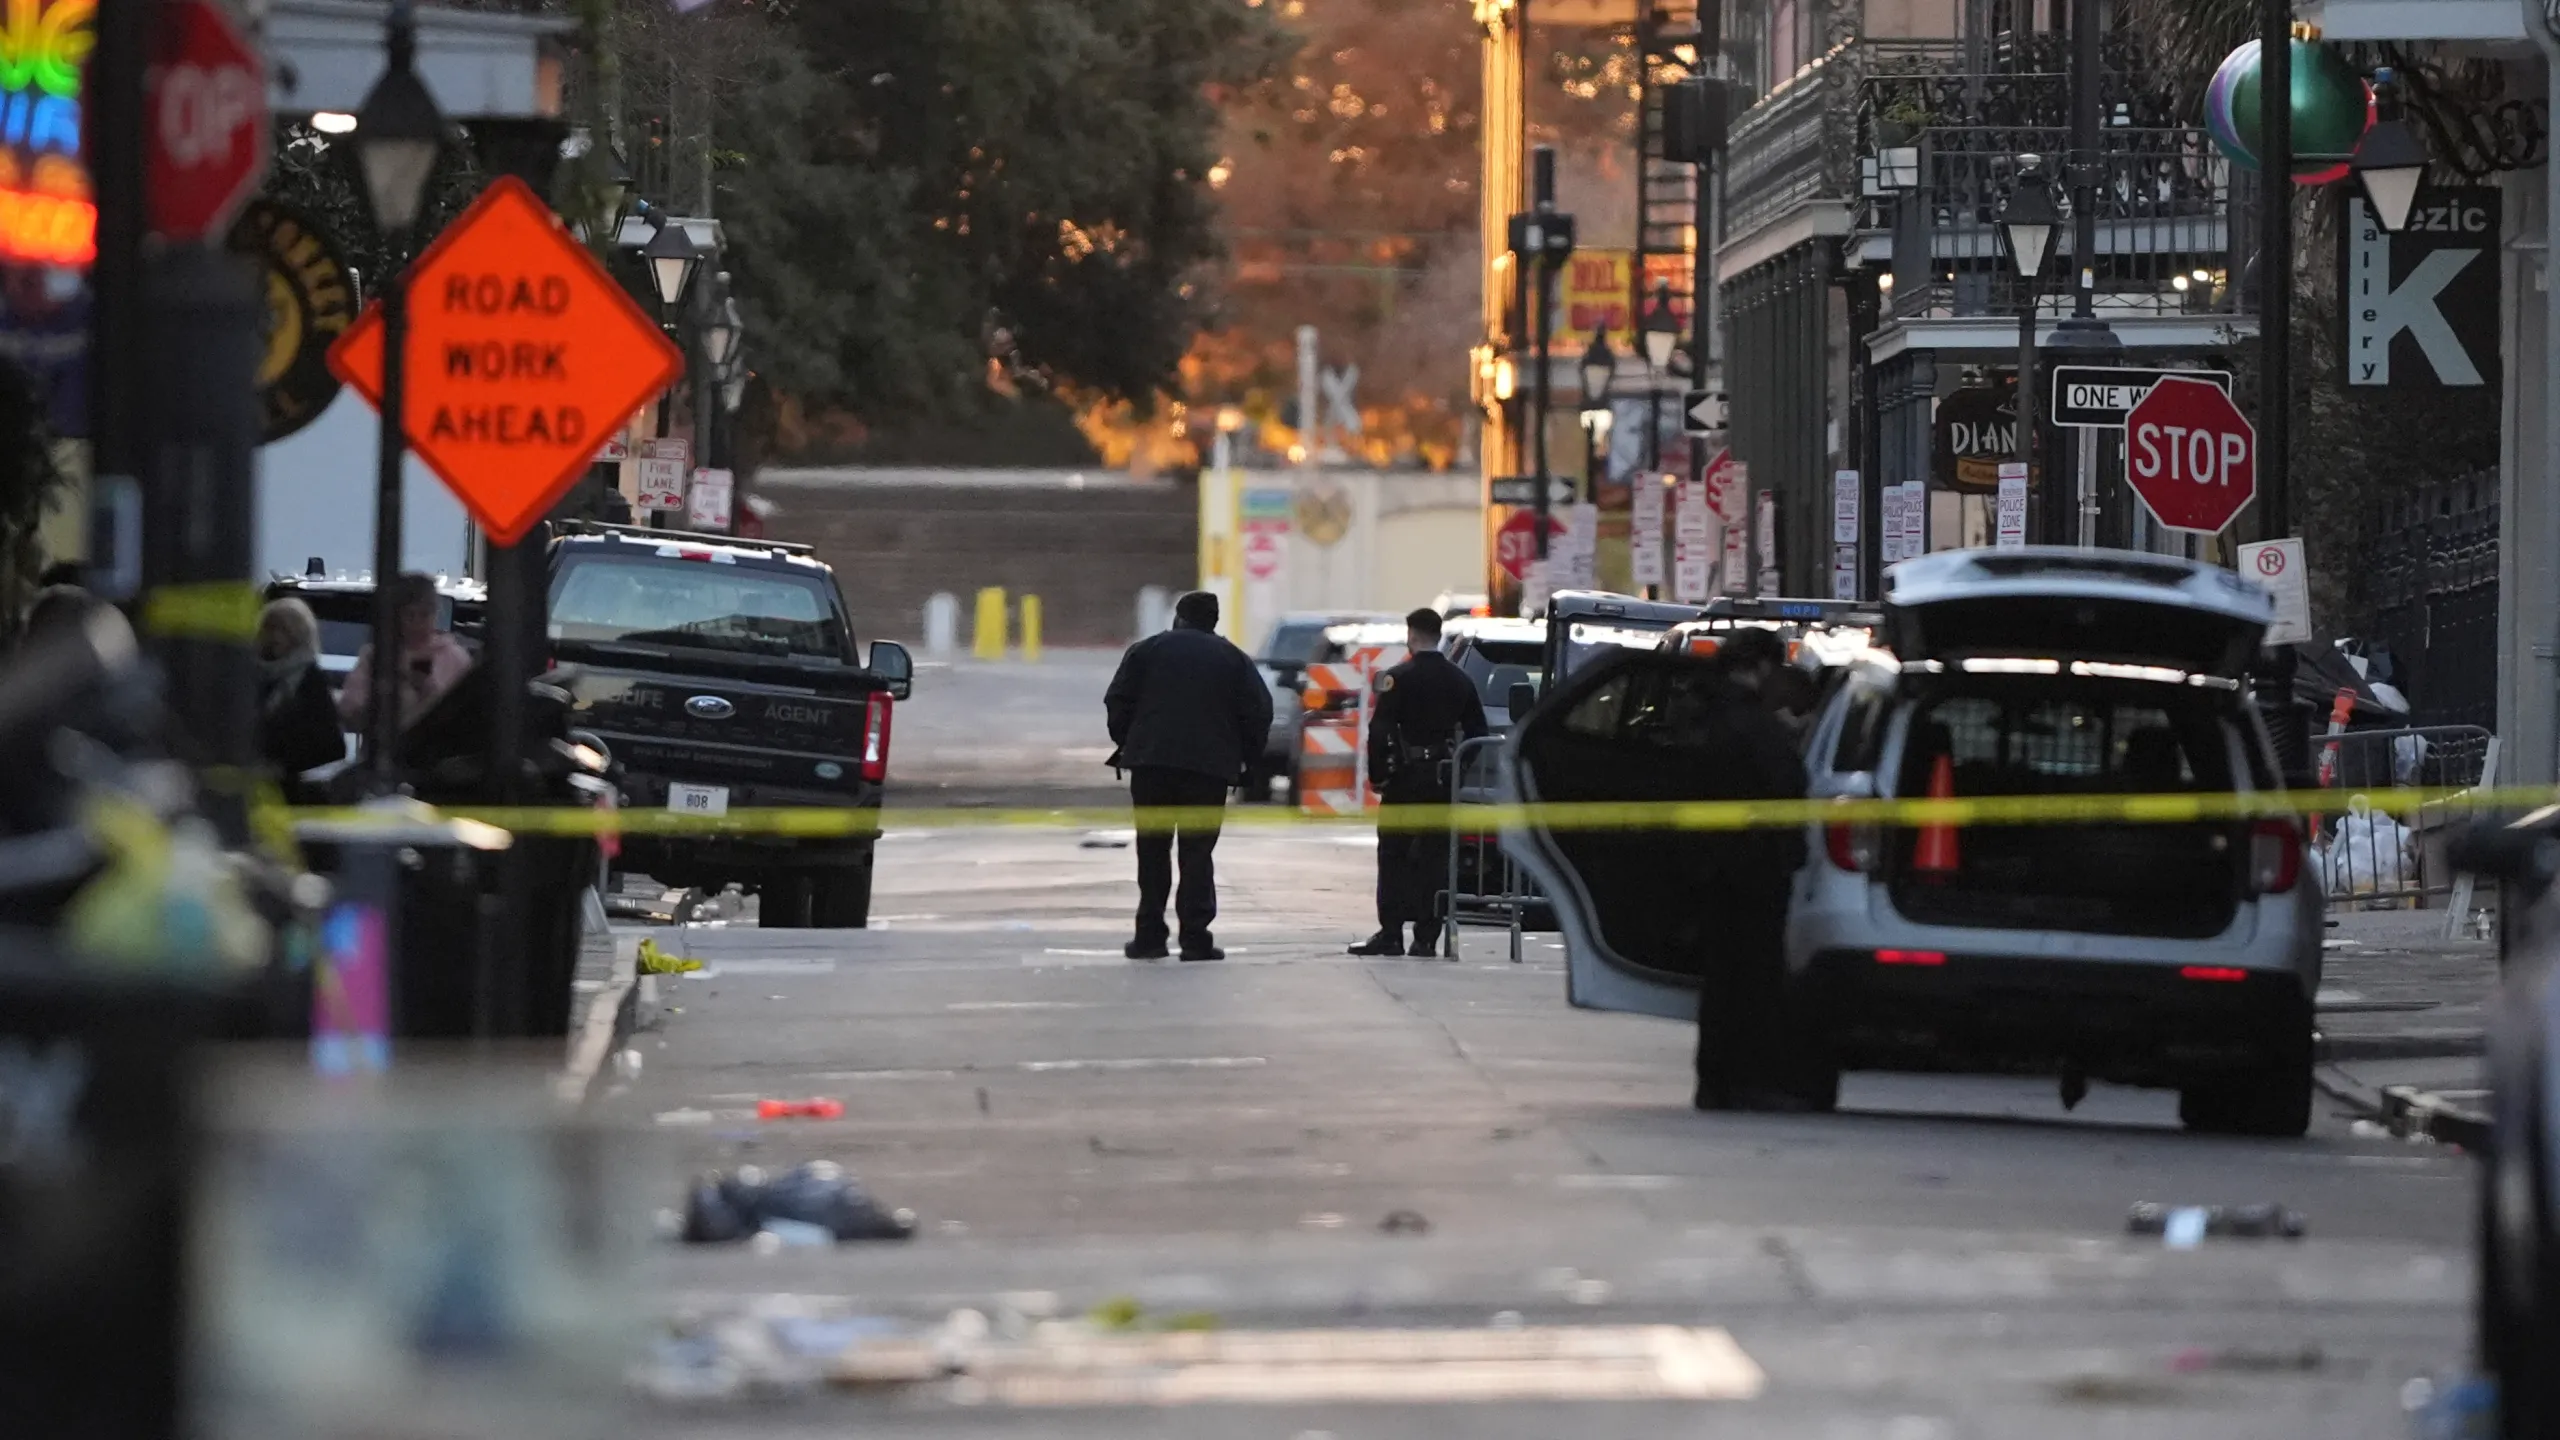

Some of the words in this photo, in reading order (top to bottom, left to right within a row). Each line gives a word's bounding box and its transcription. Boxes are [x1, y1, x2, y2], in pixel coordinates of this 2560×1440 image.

[160, 66, 260, 166] OP
[443, 272, 571, 317] ROAD
[443, 341, 569, 382] WORK
[2074, 386, 2119, 408] ONE
[429, 403, 586, 446] AHEAD
[1951, 421, 2017, 455] DIAN
[2135, 422, 2246, 486] STOP
[650, 462, 673, 475] FIRE
[647, 478, 674, 490] LANE
[1837, 488, 1857, 500] POLICE
[1884, 504, 1903, 517] POLIC
[1904, 500, 1922, 513] POLICE
[2000, 498, 2024, 512] POLICE
[1906, 515, 1920, 528] ZONE
[2002, 514, 2021, 528] ZONE
[1502, 530, 1532, 560] ST
[1782, 604, 1820, 616] NOPD
[764, 702, 833, 725] AGENT
